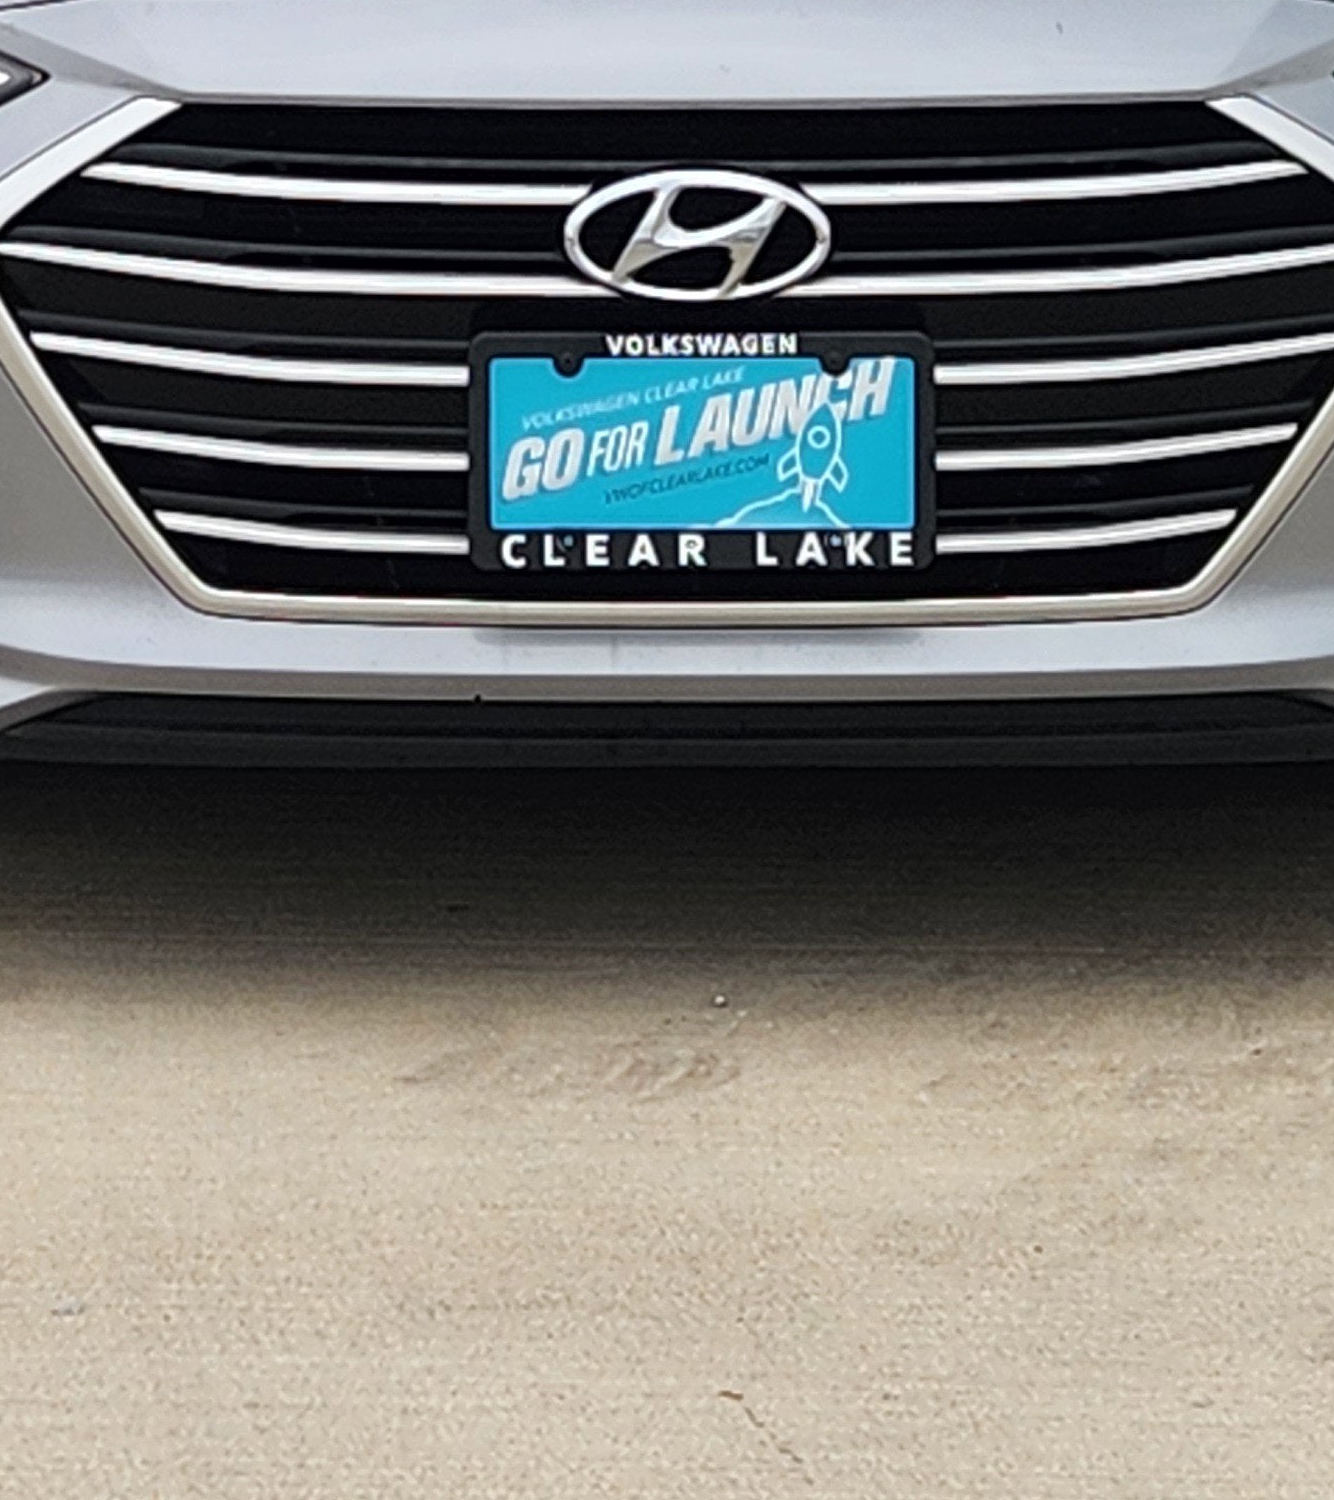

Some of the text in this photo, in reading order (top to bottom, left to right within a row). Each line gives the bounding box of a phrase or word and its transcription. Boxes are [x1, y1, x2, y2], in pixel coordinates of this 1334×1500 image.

[605, 332, 798, 357] VOLKSWAGEN
[521, 365, 747, 432] VOLKSWAGEN CLEAR LAKE
[501, 355, 897, 501] GO FOR LAUNCH
[501, 530, 915, 568] CLEAR LAKE
